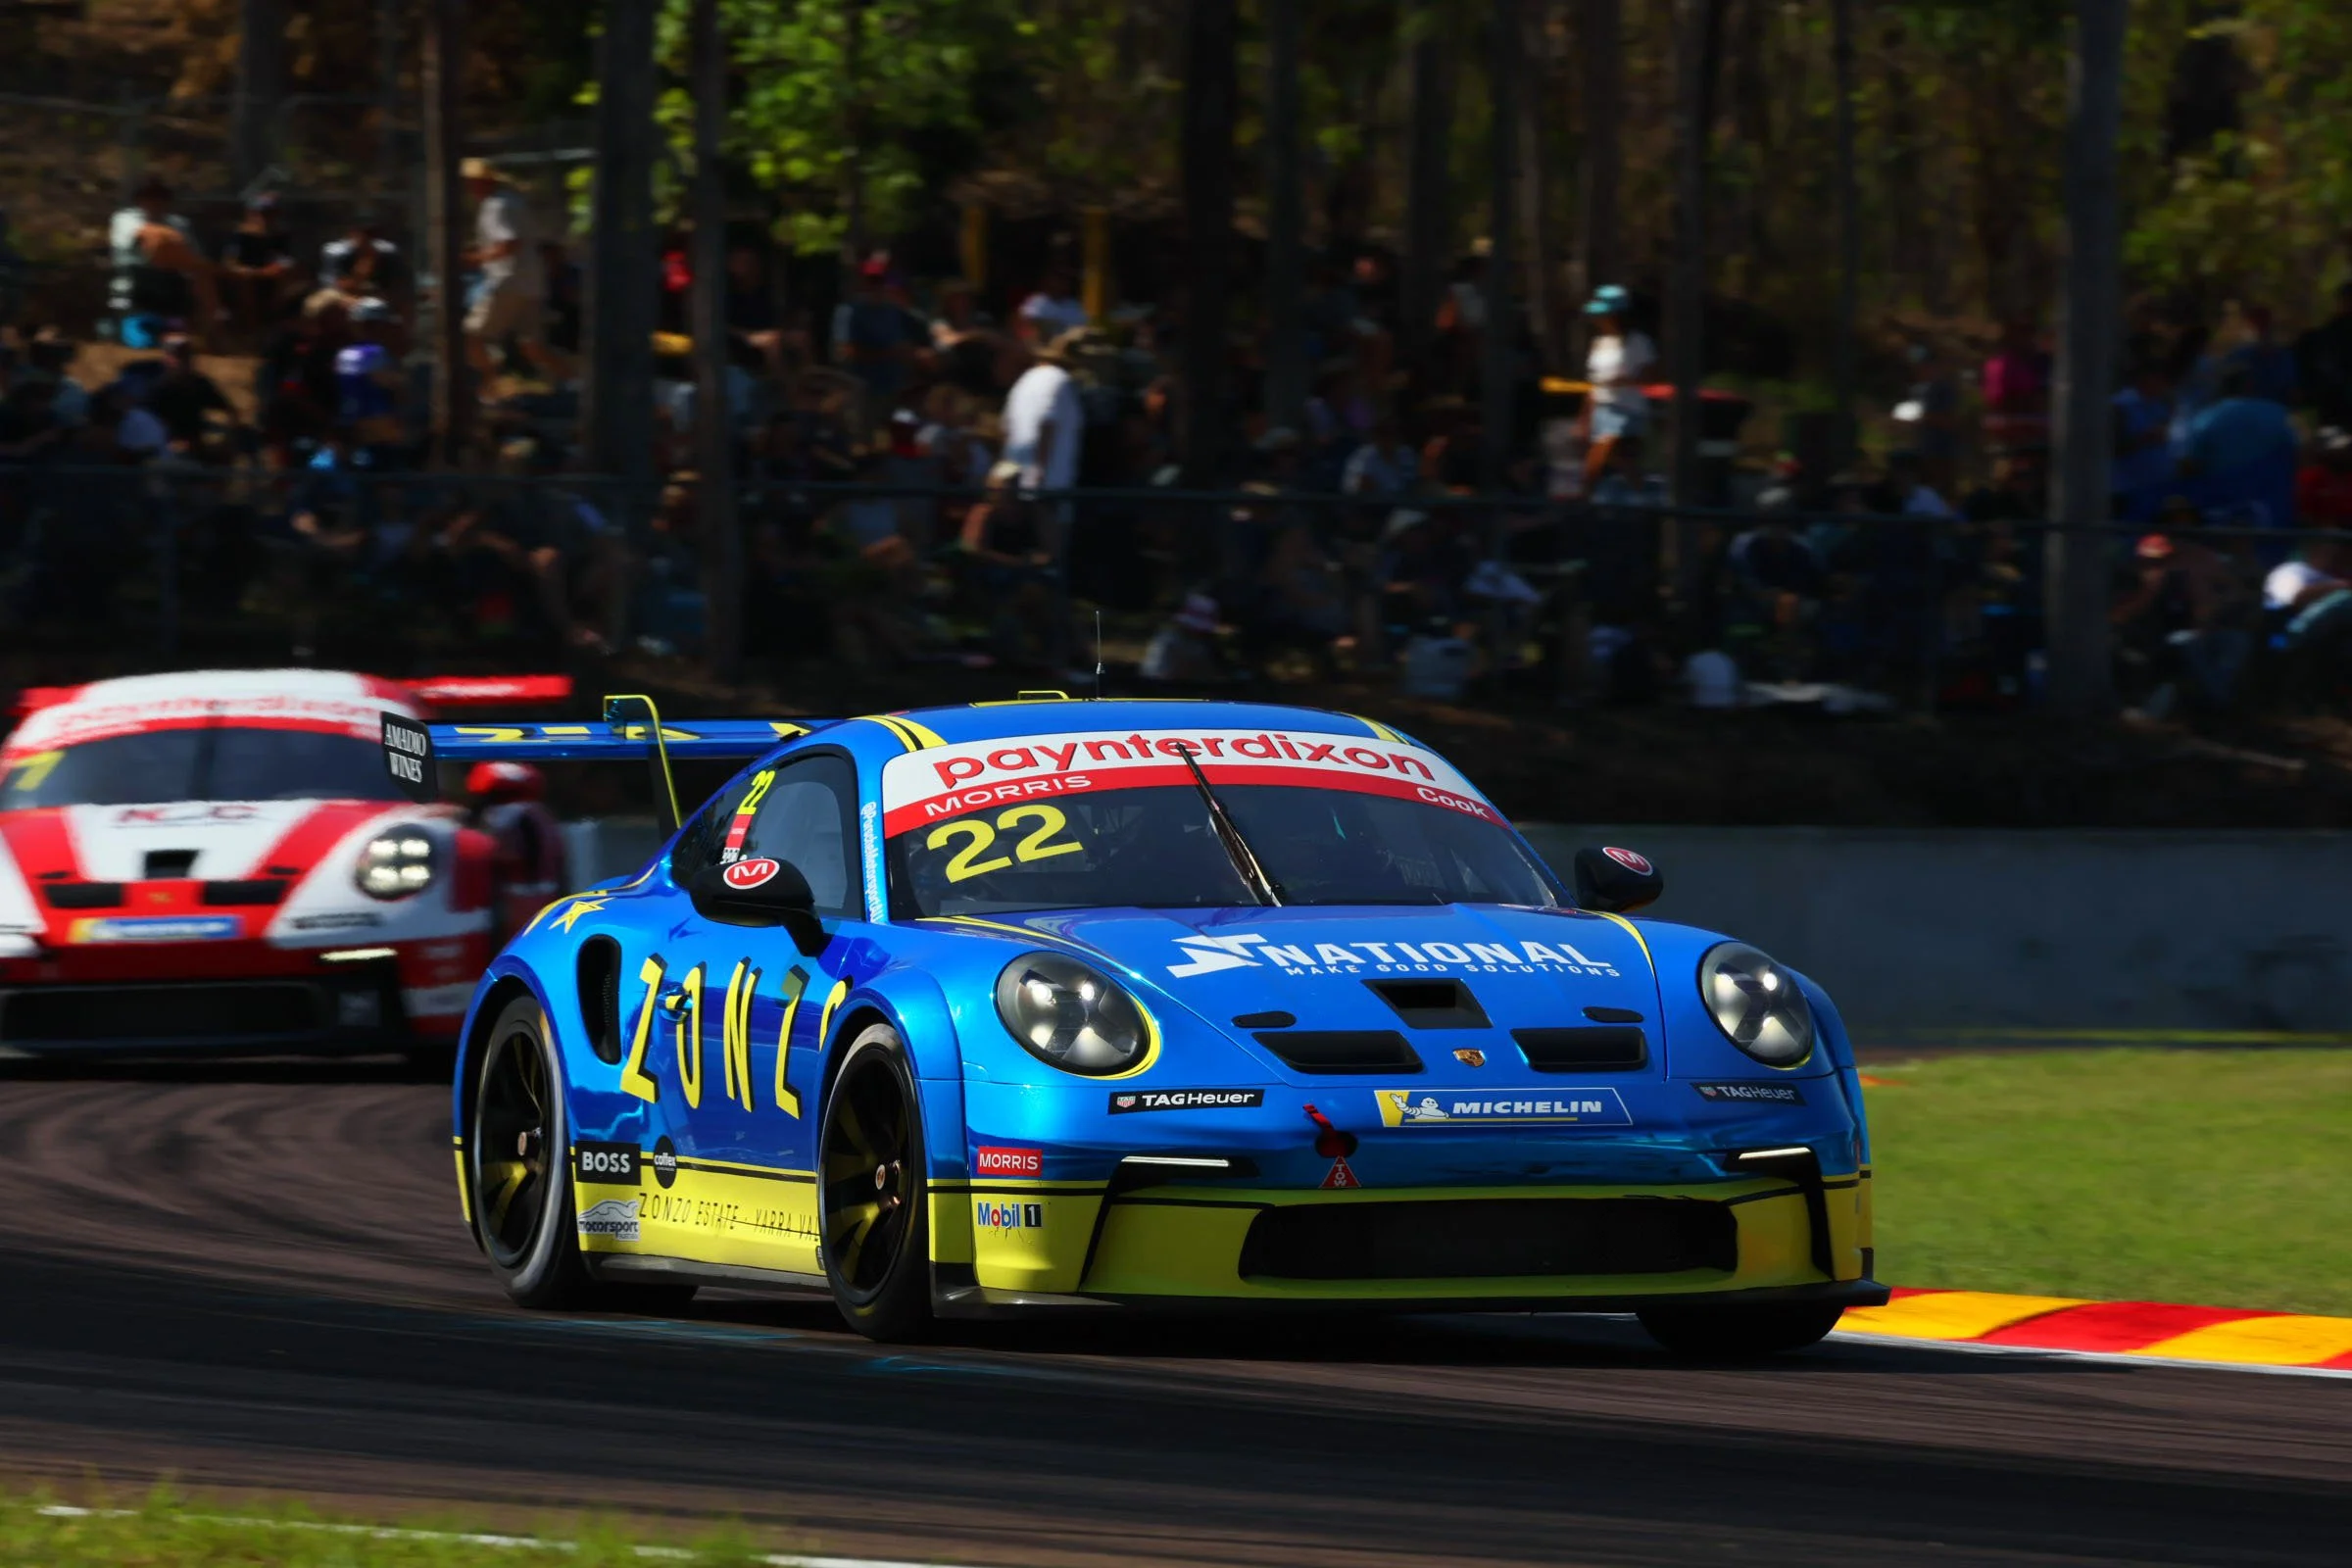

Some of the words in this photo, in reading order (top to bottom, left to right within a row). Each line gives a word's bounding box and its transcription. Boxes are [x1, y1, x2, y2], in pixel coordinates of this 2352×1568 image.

[384, 723, 426, 757] AMADIO
[389, 752, 422, 783] WINES
[933, 732, 1437, 789] paynterdixon
[736, 770, 775, 815] 22
[925, 774, 1092, 817] MORRIS
[1417, 786, 1490, 819] Cook
[926, 804, 1083, 883] 22
[1256, 941, 1612, 968] NATIONAL
[1284, 964, 1361, 976] MAKE
[1464, 963, 1621, 977] SOLUTIONS
[1452, 1100, 1602, 1114] MICHELIN
[582, 1152, 630, 1173] BOSS
[979, 1152, 1039, 1170] MORRIS
[639, 1192, 692, 1223] ZONZO
[695, 1200, 739, 1230] ESTATE
[977, 1201, 1020, 1228] Mobil
